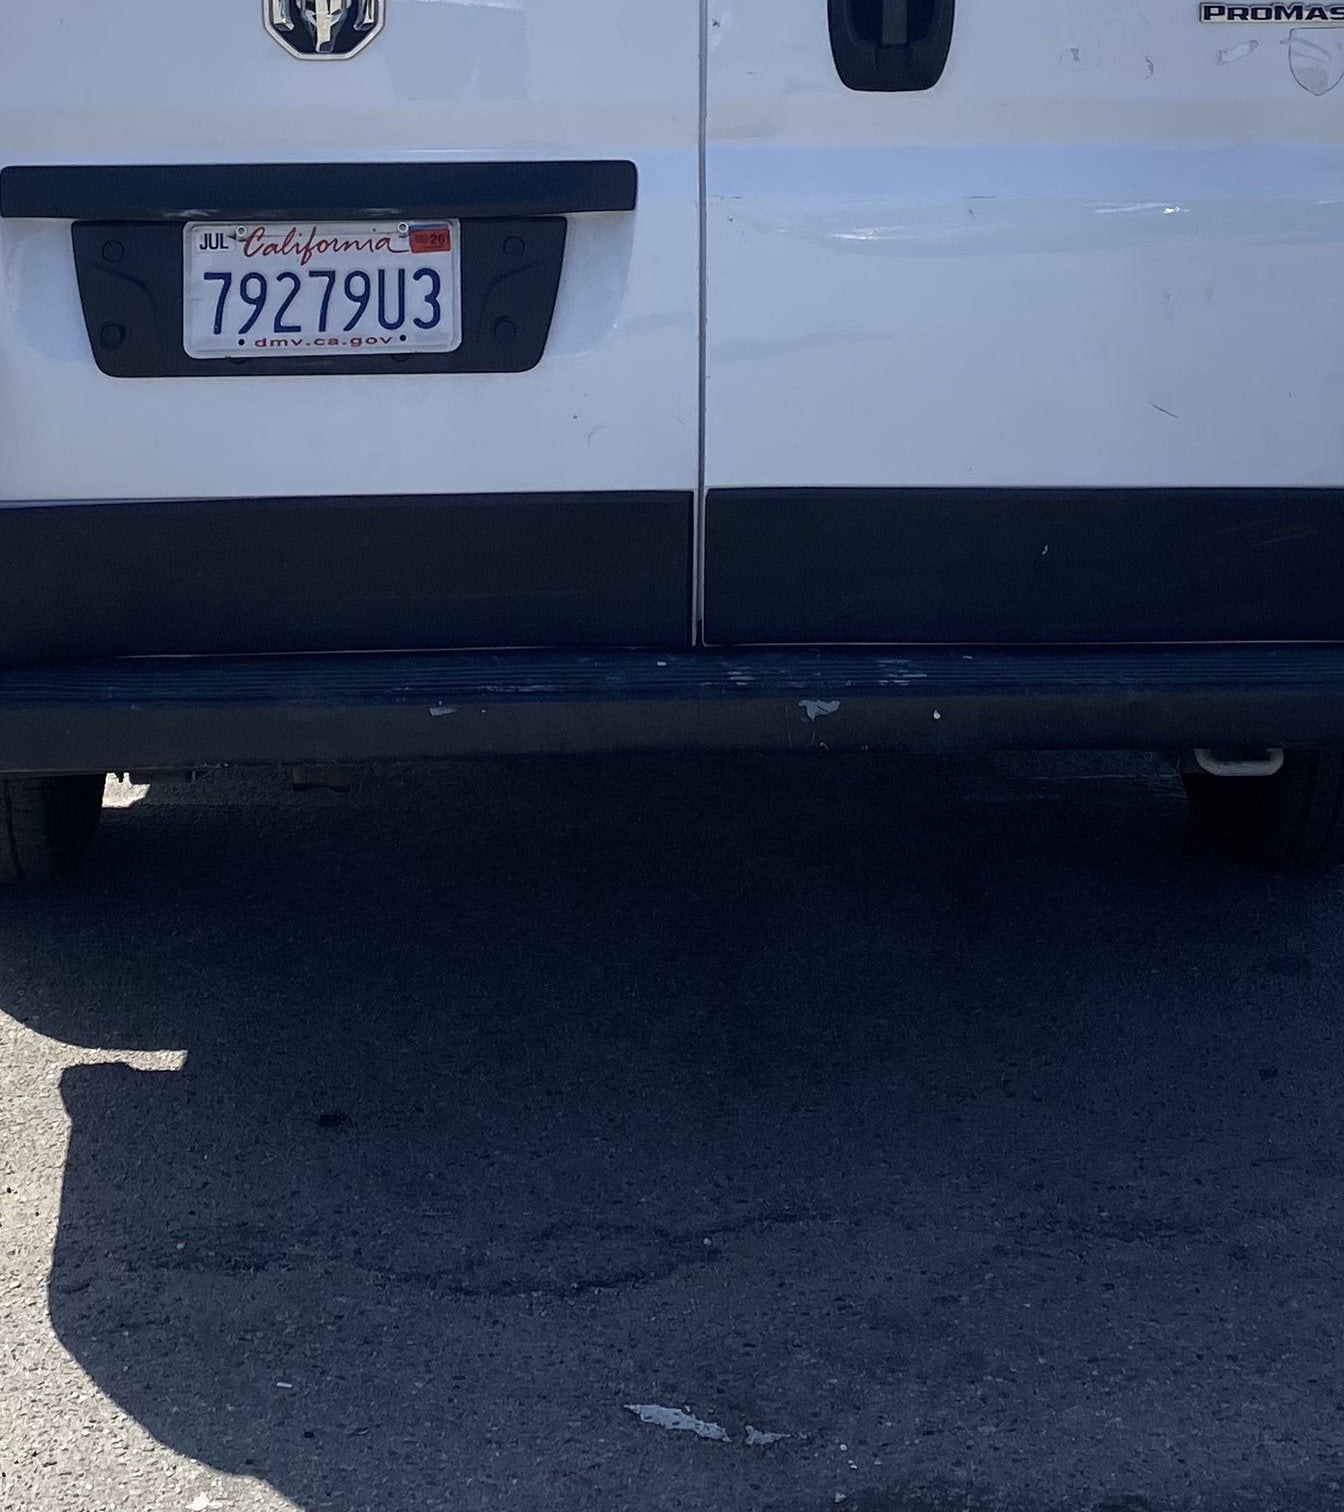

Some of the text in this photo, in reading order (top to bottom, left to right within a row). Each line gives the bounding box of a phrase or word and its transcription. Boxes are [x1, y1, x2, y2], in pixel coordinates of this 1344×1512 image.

[199, 232, 229, 251] JUL
[238, 225, 410, 266] California
[203, 267, 442, 335] 79279U3
[254, 335, 393, 348] dmv.ca.gov
